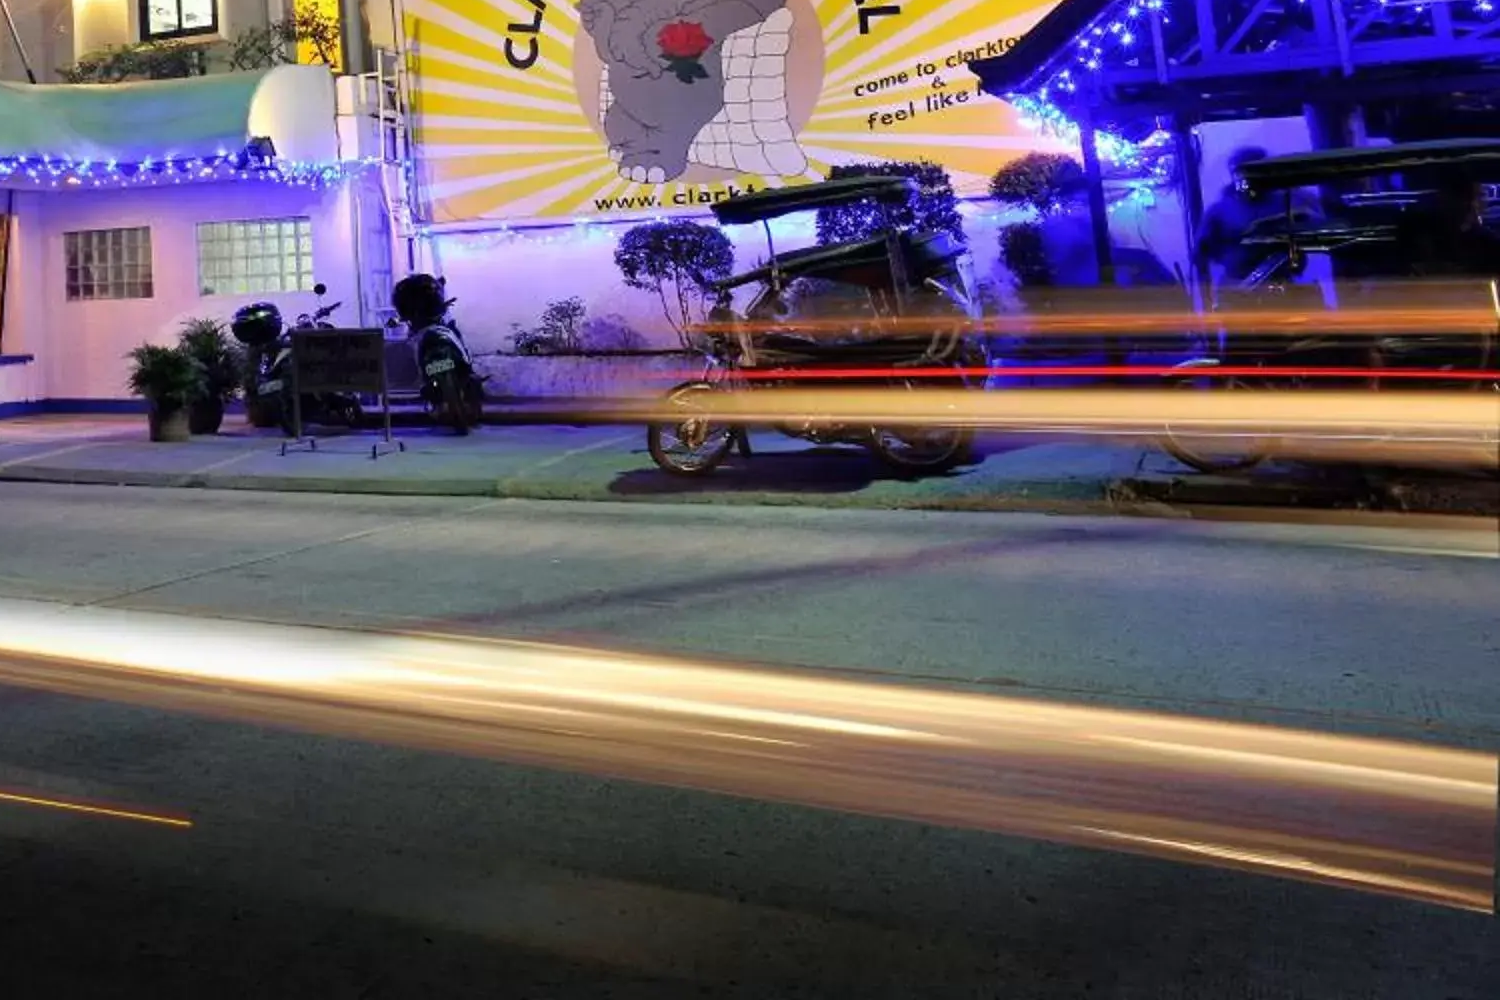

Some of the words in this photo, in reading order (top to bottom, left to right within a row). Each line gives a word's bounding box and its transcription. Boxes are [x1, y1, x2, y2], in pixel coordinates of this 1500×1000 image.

[854, 72, 909, 97] come
[916, 61, 936, 76] to
[946, 35, 1025, 69] clarkto
[931, 75, 946, 89] &
[868, 101, 916, 129] feel
[925, 89, 969, 113] like
[595, 194, 662, 211] www.
[672, 183, 756, 205] clarkt
